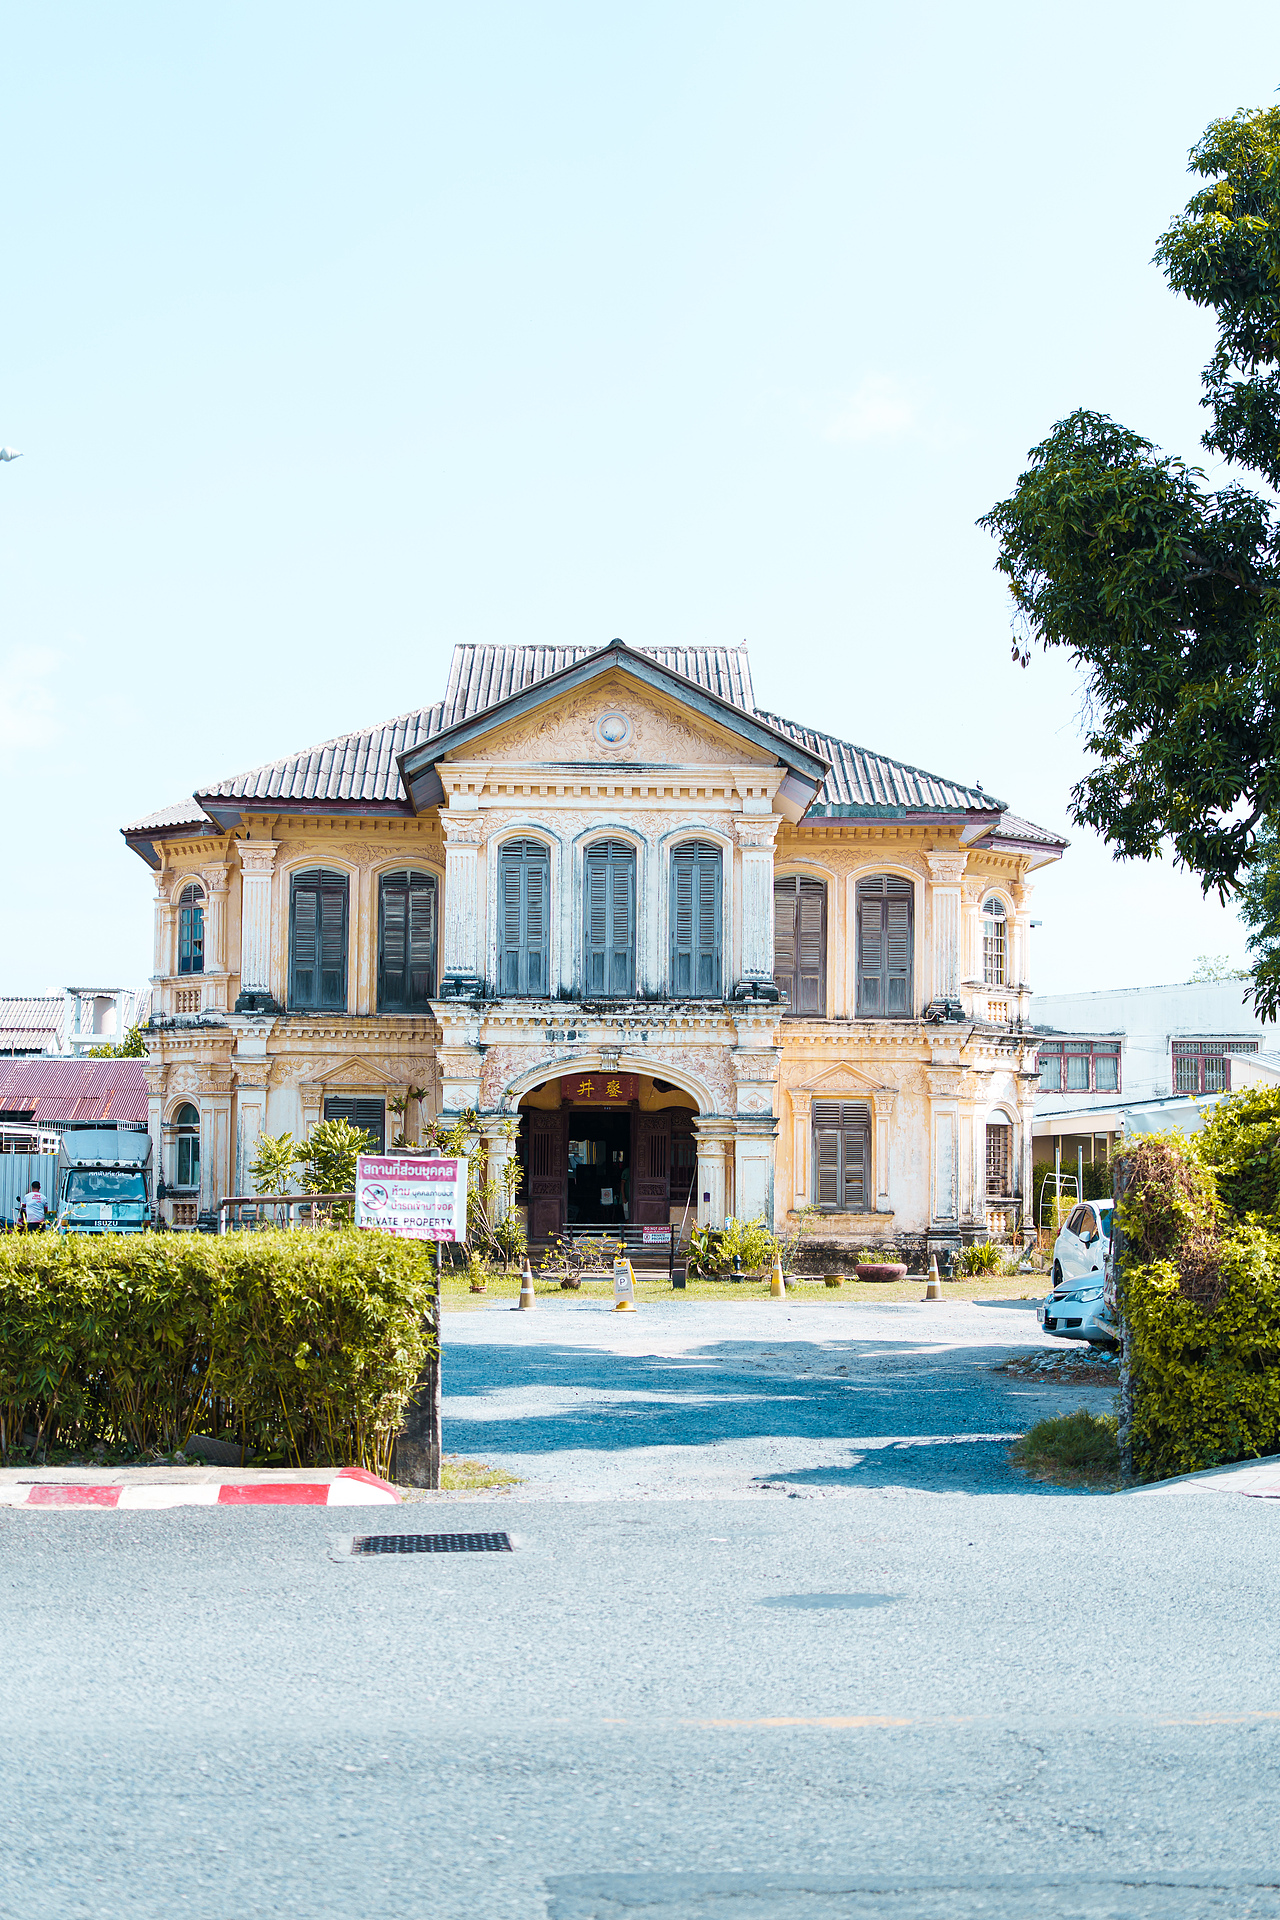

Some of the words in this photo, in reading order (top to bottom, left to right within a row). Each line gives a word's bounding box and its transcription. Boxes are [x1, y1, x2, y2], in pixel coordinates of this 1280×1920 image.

[363, 1160, 453, 1180] สถานที่ส่วนบุคคล
[391, 1185, 410, 1196] ห้าม
[360, 1216, 398, 1226] PRIVATE
[403, 1217, 453, 1227] PROPERTY
[395, 1228, 434, 1239] PARKING
